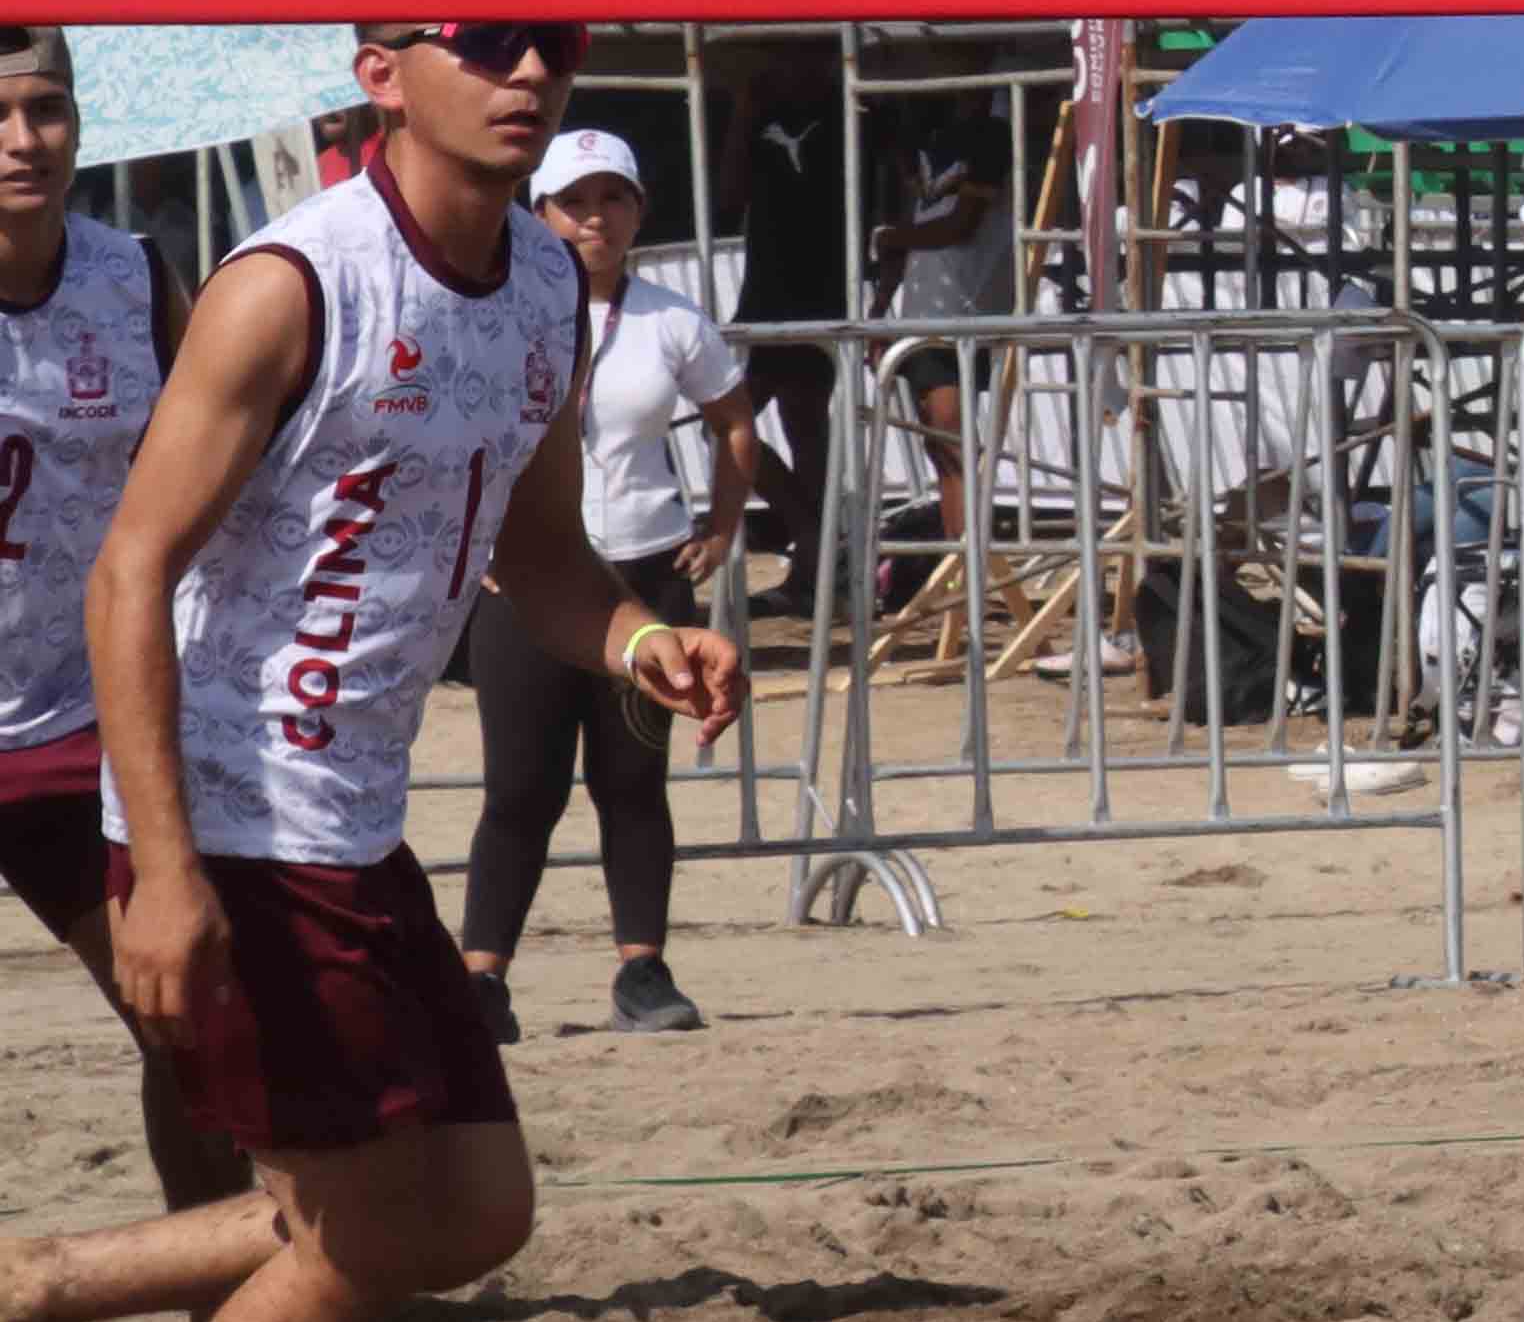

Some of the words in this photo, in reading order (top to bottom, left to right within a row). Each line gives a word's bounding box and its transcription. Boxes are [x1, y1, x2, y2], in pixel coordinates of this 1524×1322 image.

[373, 395, 427, 415] FMVB
[448, 447, 486, 600] 1
[280, 460, 398, 752] COLIMA
